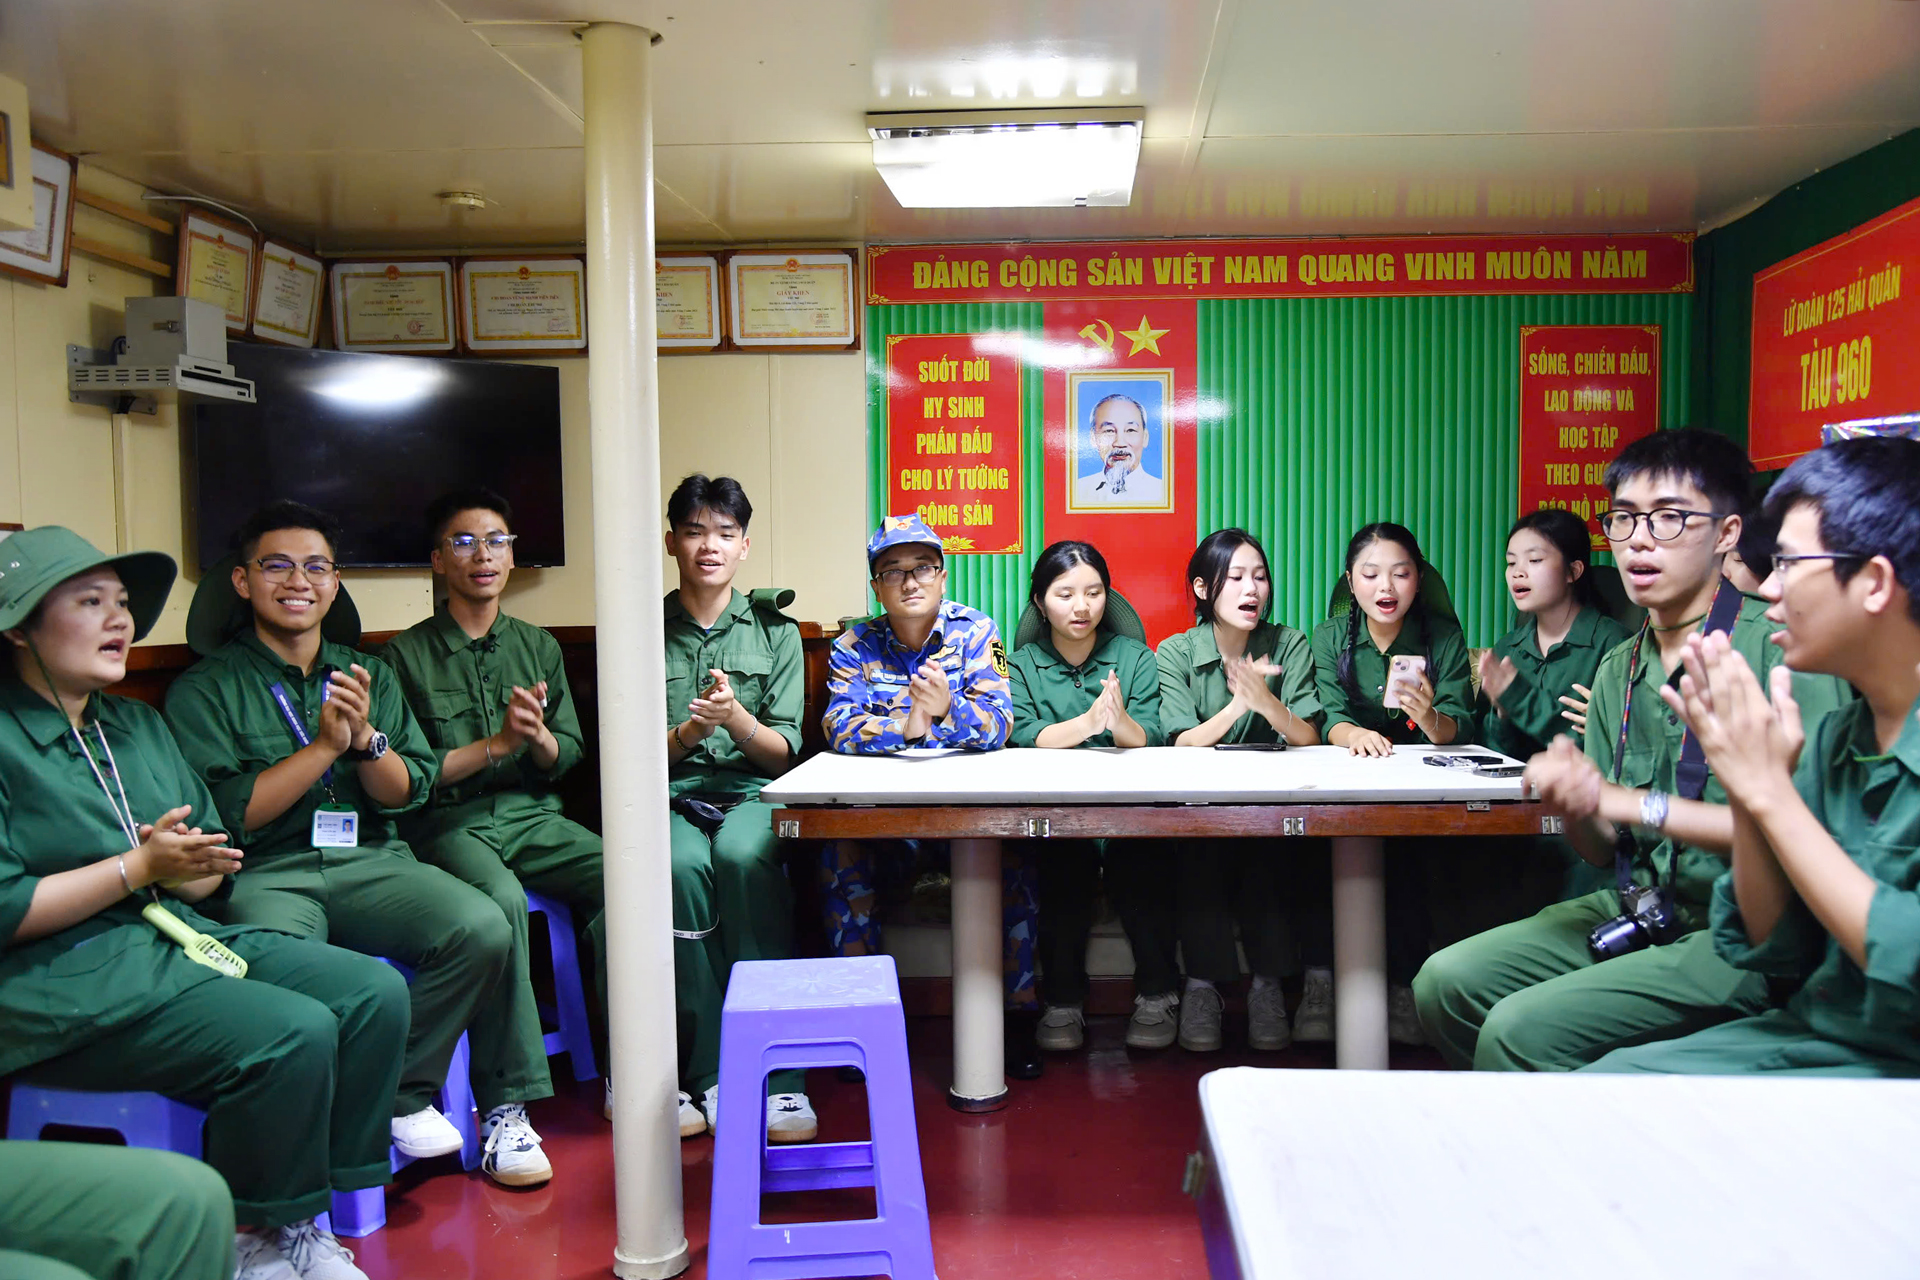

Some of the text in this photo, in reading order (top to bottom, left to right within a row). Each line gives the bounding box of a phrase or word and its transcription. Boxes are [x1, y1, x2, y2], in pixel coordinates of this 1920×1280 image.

[913, 245, 1647, 292] ĐẢNG CỘNG SẢN VIỆT NAM QUANG VINH MUÔN NĂM
[1796, 291, 1825, 333] ĐOÀN
[1827, 287, 1846, 322] 125
[1847, 266, 1866, 316] HẢI
[1868, 261, 1901, 311] QUÂN
[918, 354, 990, 383] SUỐT ĐỜI
[1528, 346, 1651, 376] SỐNG, CHIẾN ĐẤU,
[1801, 335, 1872, 412] TÀU 960
[924, 395, 985, 419] HY SINH
[1544, 386, 1635, 415] LAO ĐỘNG VÀ
[916, 424, 993, 455] PHẤN ĐẤU
[1559, 423, 1619, 453] HỌC TẬP
[900, 462, 1010, 492] CHO LÝ TƯỞNG
[1545, 460, 1611, 486] THEO GƯ
[917, 498, 994, 529] CỘNG SẢN
[1571, 493, 1590, 522] HỒ
